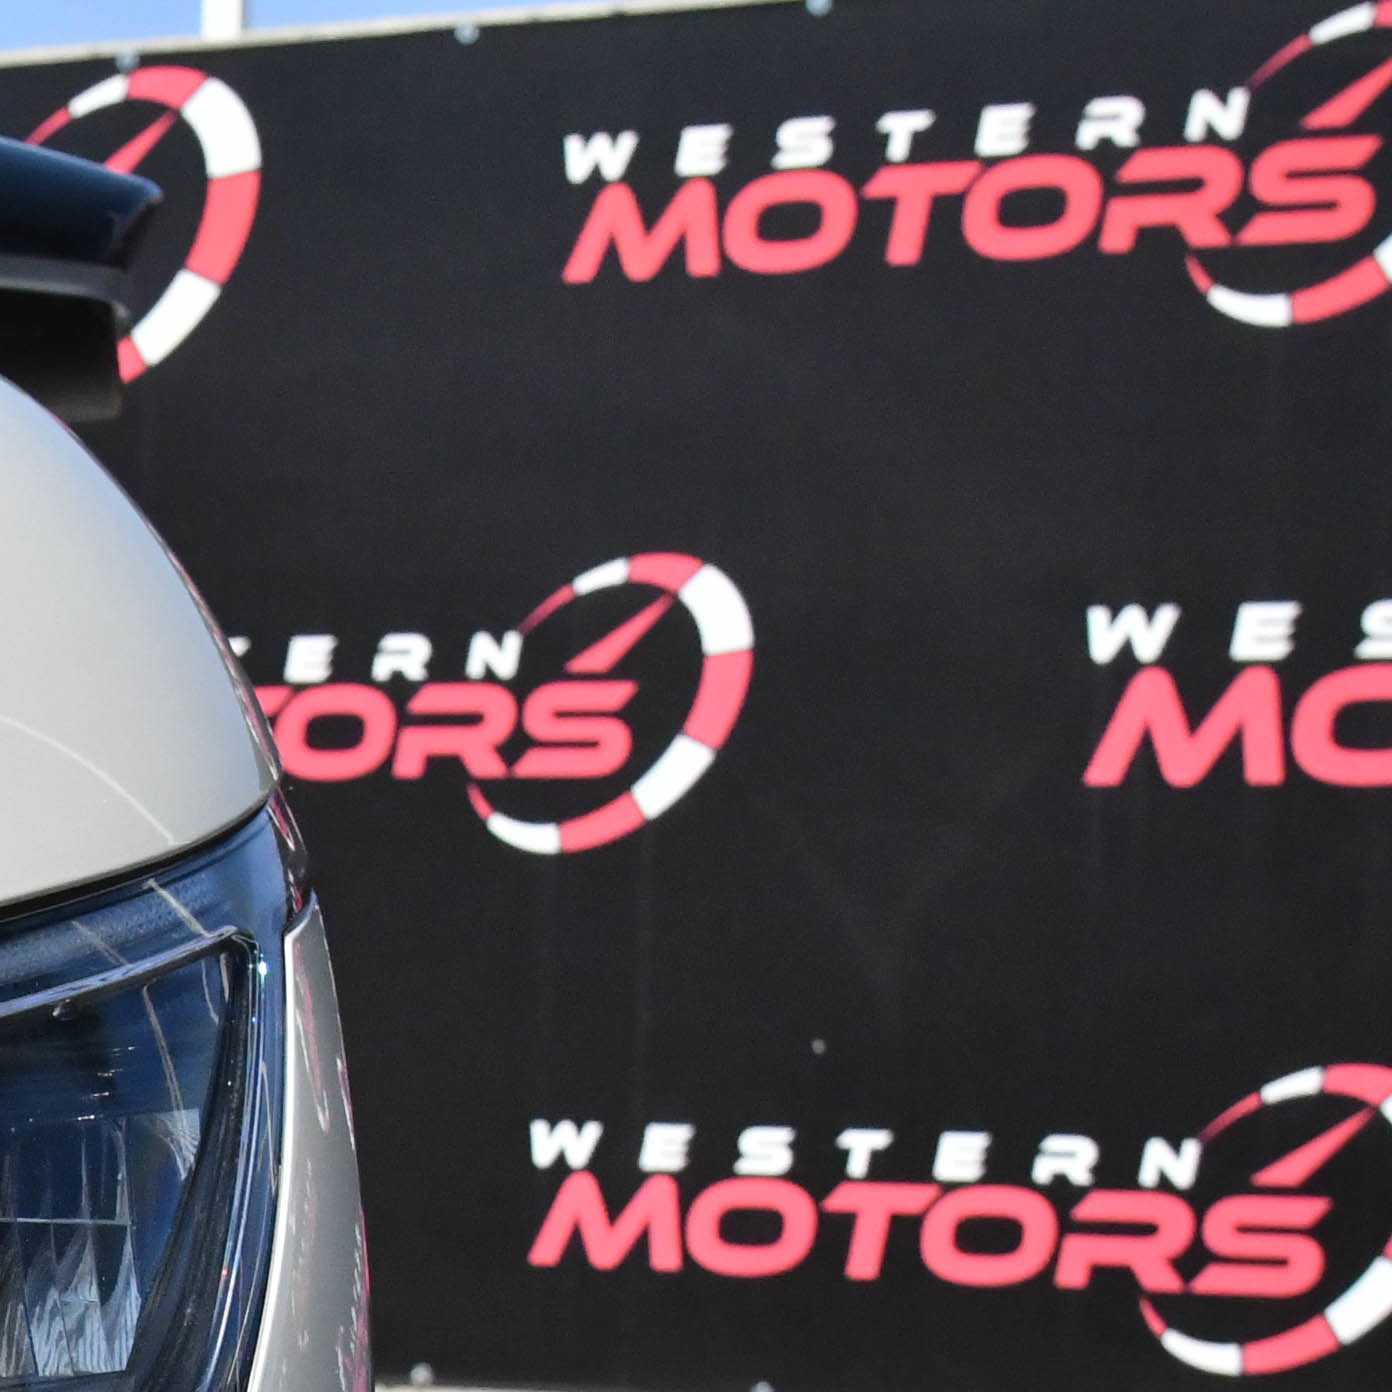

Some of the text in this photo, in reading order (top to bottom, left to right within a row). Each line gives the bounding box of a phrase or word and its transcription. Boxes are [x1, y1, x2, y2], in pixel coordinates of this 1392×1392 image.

[563, 86, 1250, 184] WESTERN
[561, 134, 1383, 284] MOTORS
[228, 630, 523, 684] ERN
[528, 1119, 1202, 1190] WESTERN
[527, 1170, 1332, 1299] MOTORS
